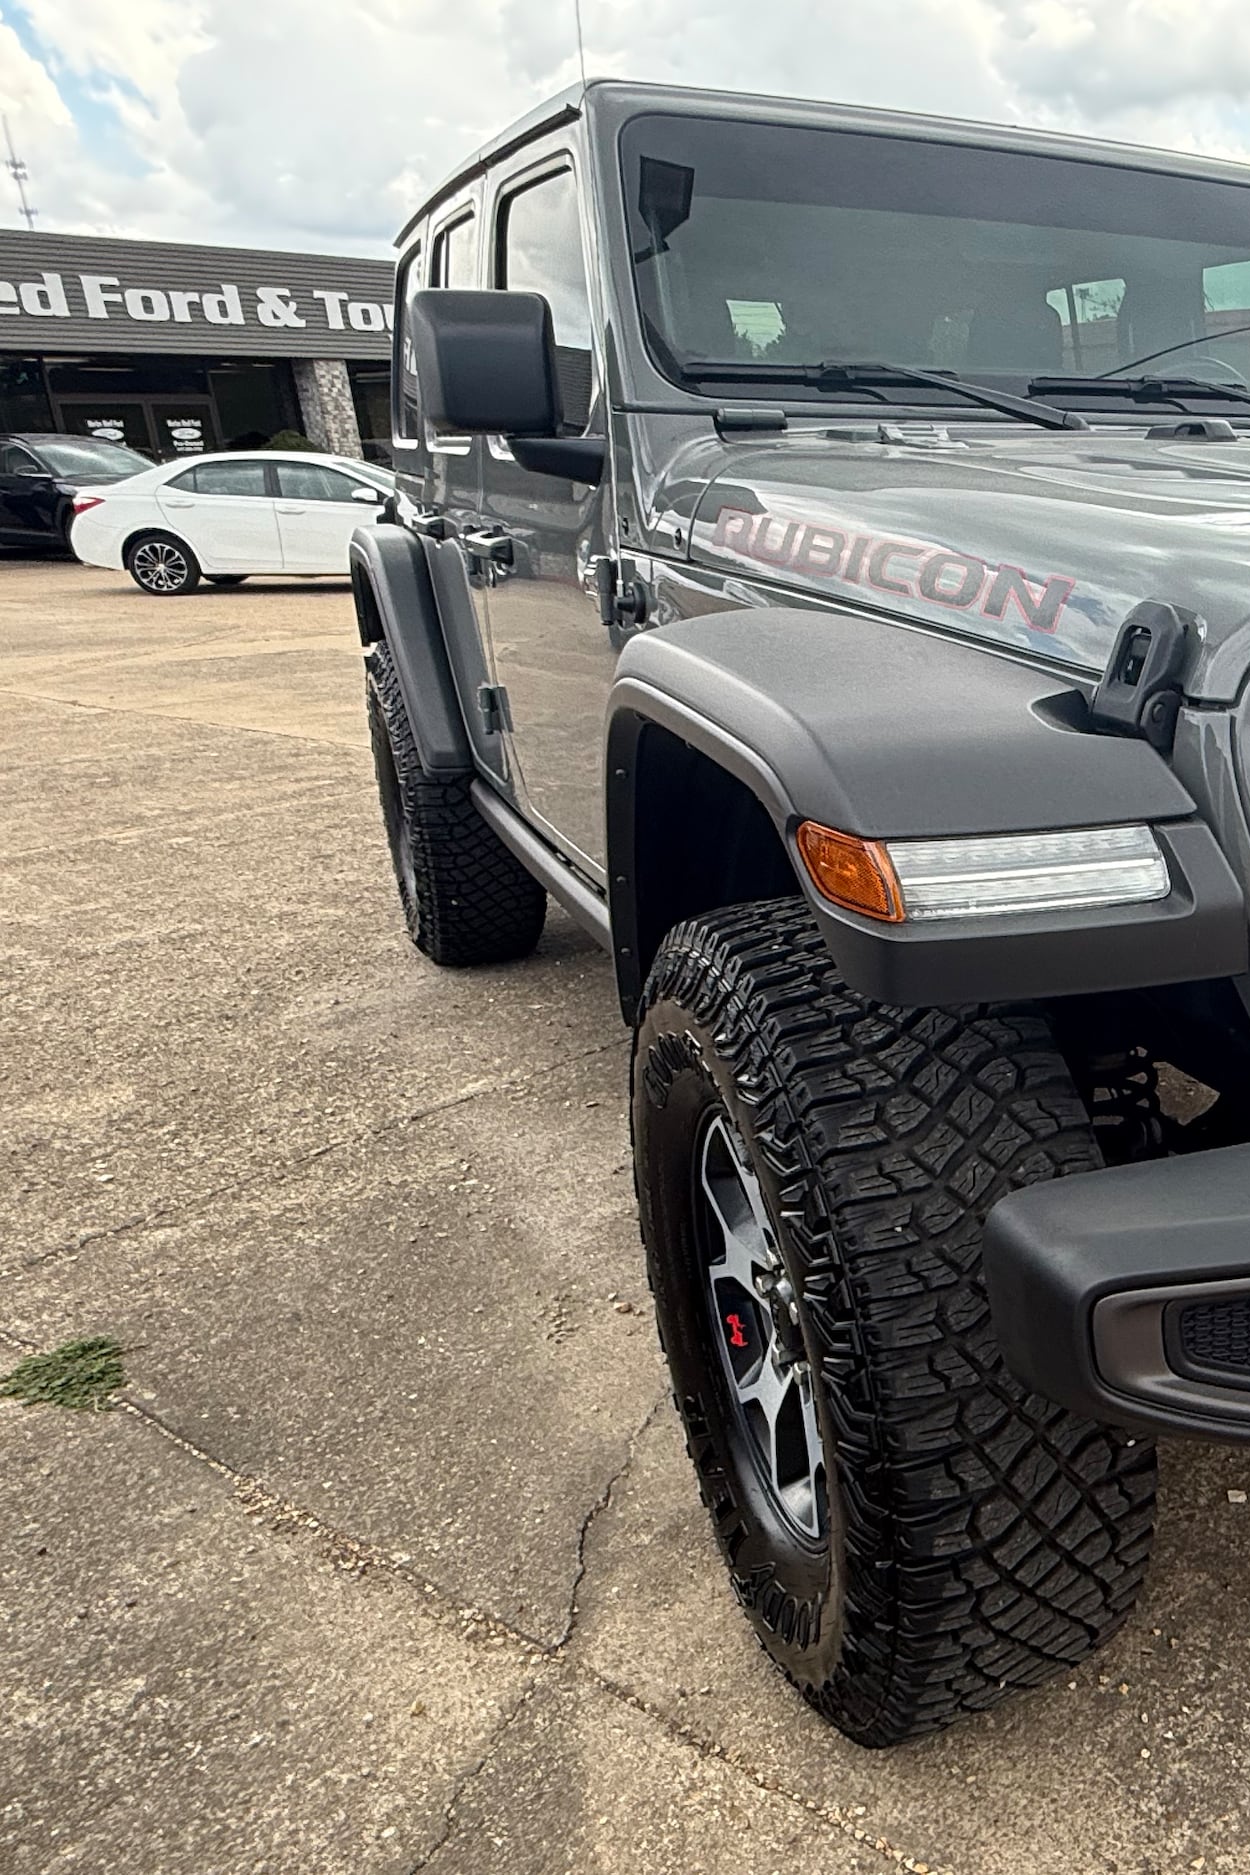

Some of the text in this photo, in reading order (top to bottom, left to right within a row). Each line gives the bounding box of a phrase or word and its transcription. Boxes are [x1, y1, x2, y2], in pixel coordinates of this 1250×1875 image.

[78, 274, 246, 325] Ford
[256, 287, 306, 328] &
[313, 289, 394, 343] To
[712, 506, 1077, 635] RUBICON
